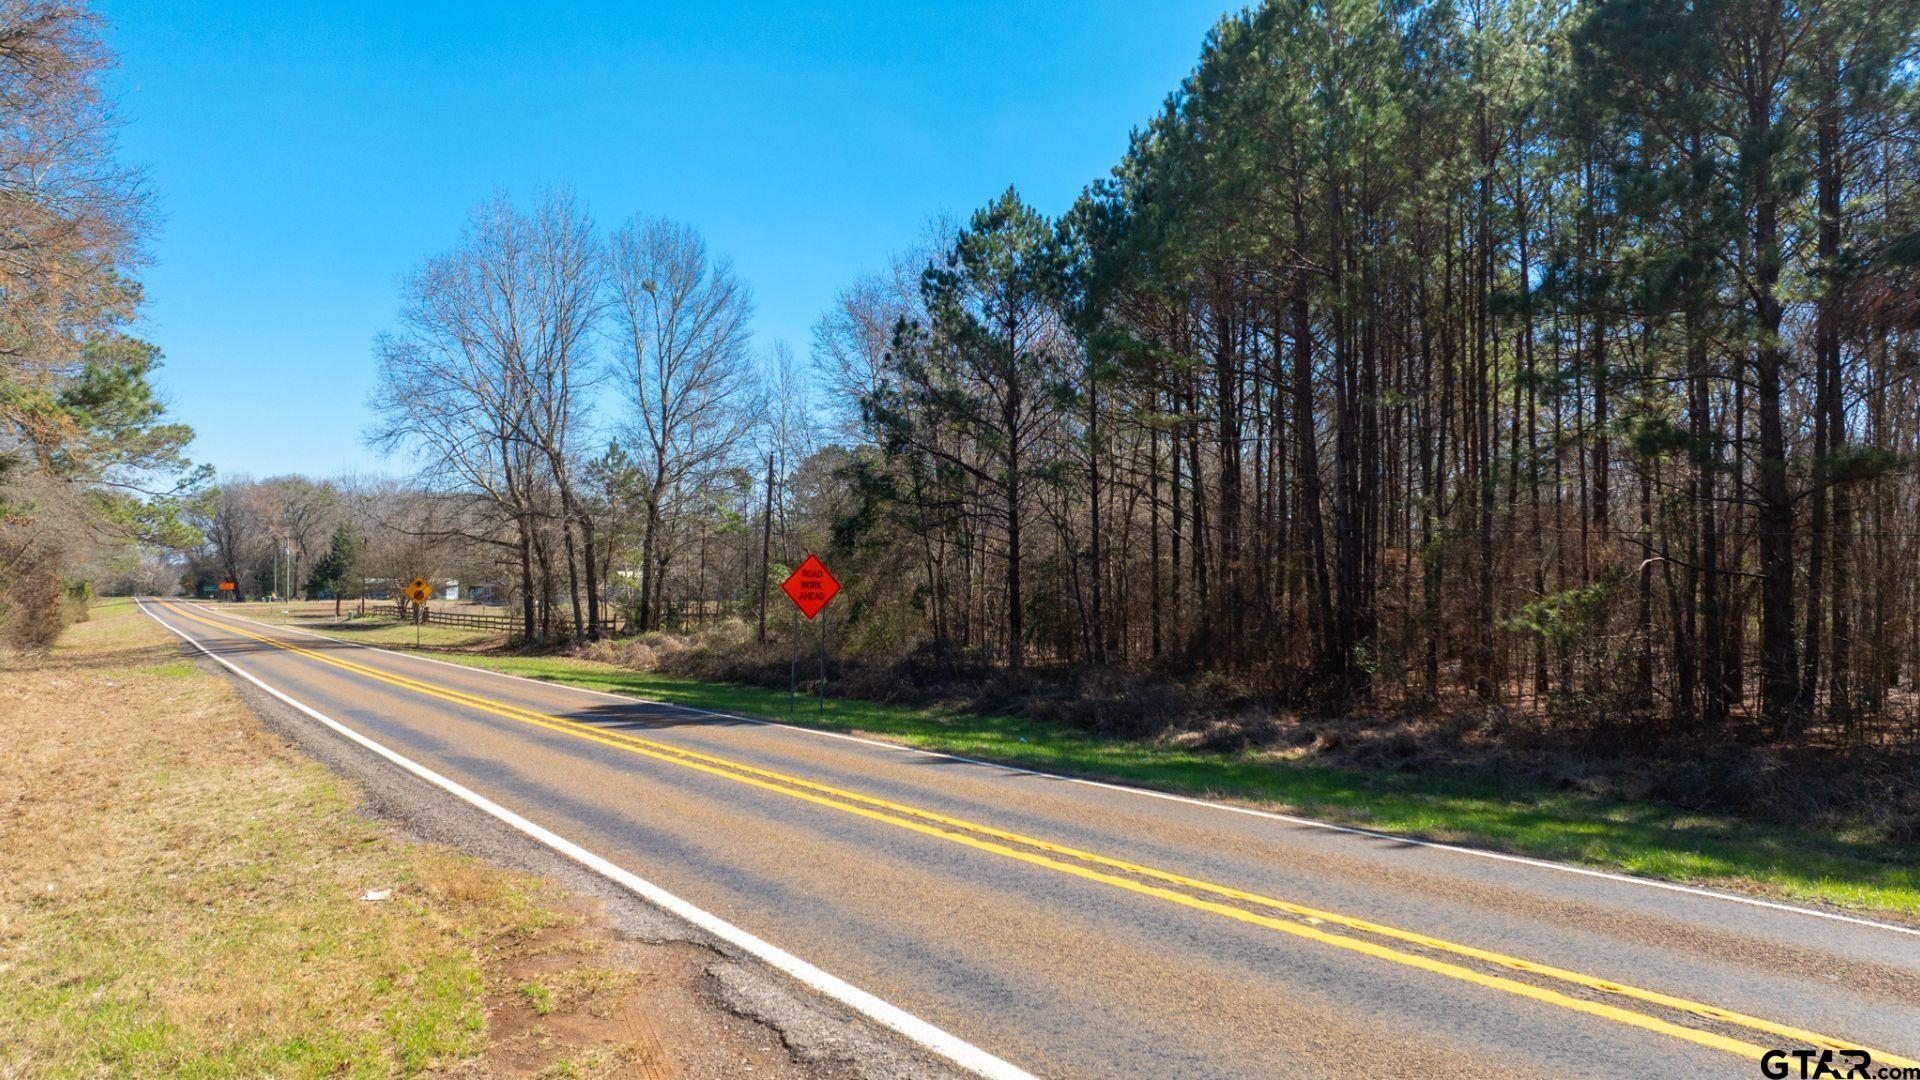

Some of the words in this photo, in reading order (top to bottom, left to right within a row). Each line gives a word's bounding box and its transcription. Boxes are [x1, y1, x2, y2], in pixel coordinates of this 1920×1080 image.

[802, 570, 823, 578] ROAD
[801, 581, 822, 589] WORK
[800, 592, 825, 600] AHEAD
